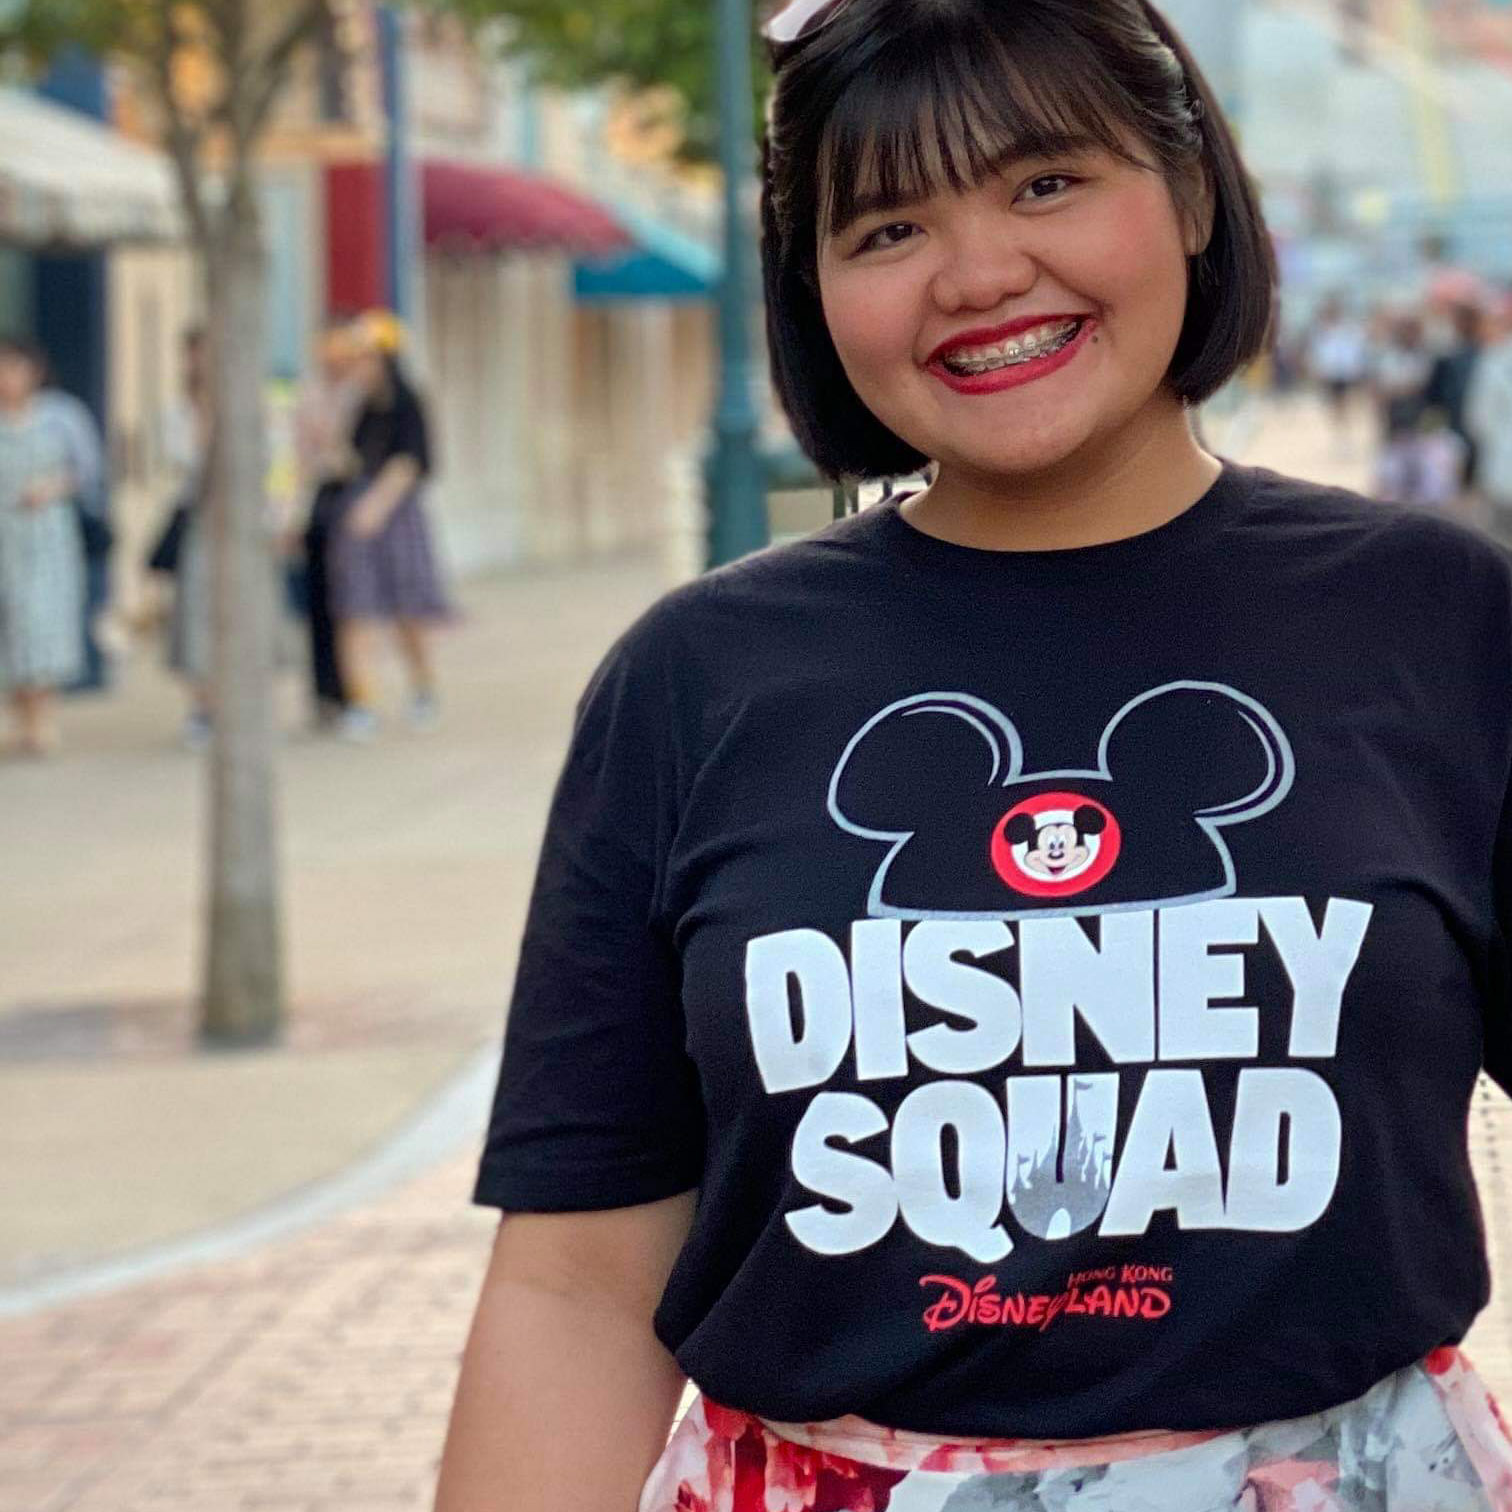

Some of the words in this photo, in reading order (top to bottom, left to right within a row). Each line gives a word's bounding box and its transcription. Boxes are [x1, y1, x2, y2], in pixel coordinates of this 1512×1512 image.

[745, 896, 1374, 1093] DISNEY
[785, 1067, 1342, 1263] SQUAD
[1067, 1266, 1116, 1287] HONG
[1121, 1263, 1174, 1284] KONG
